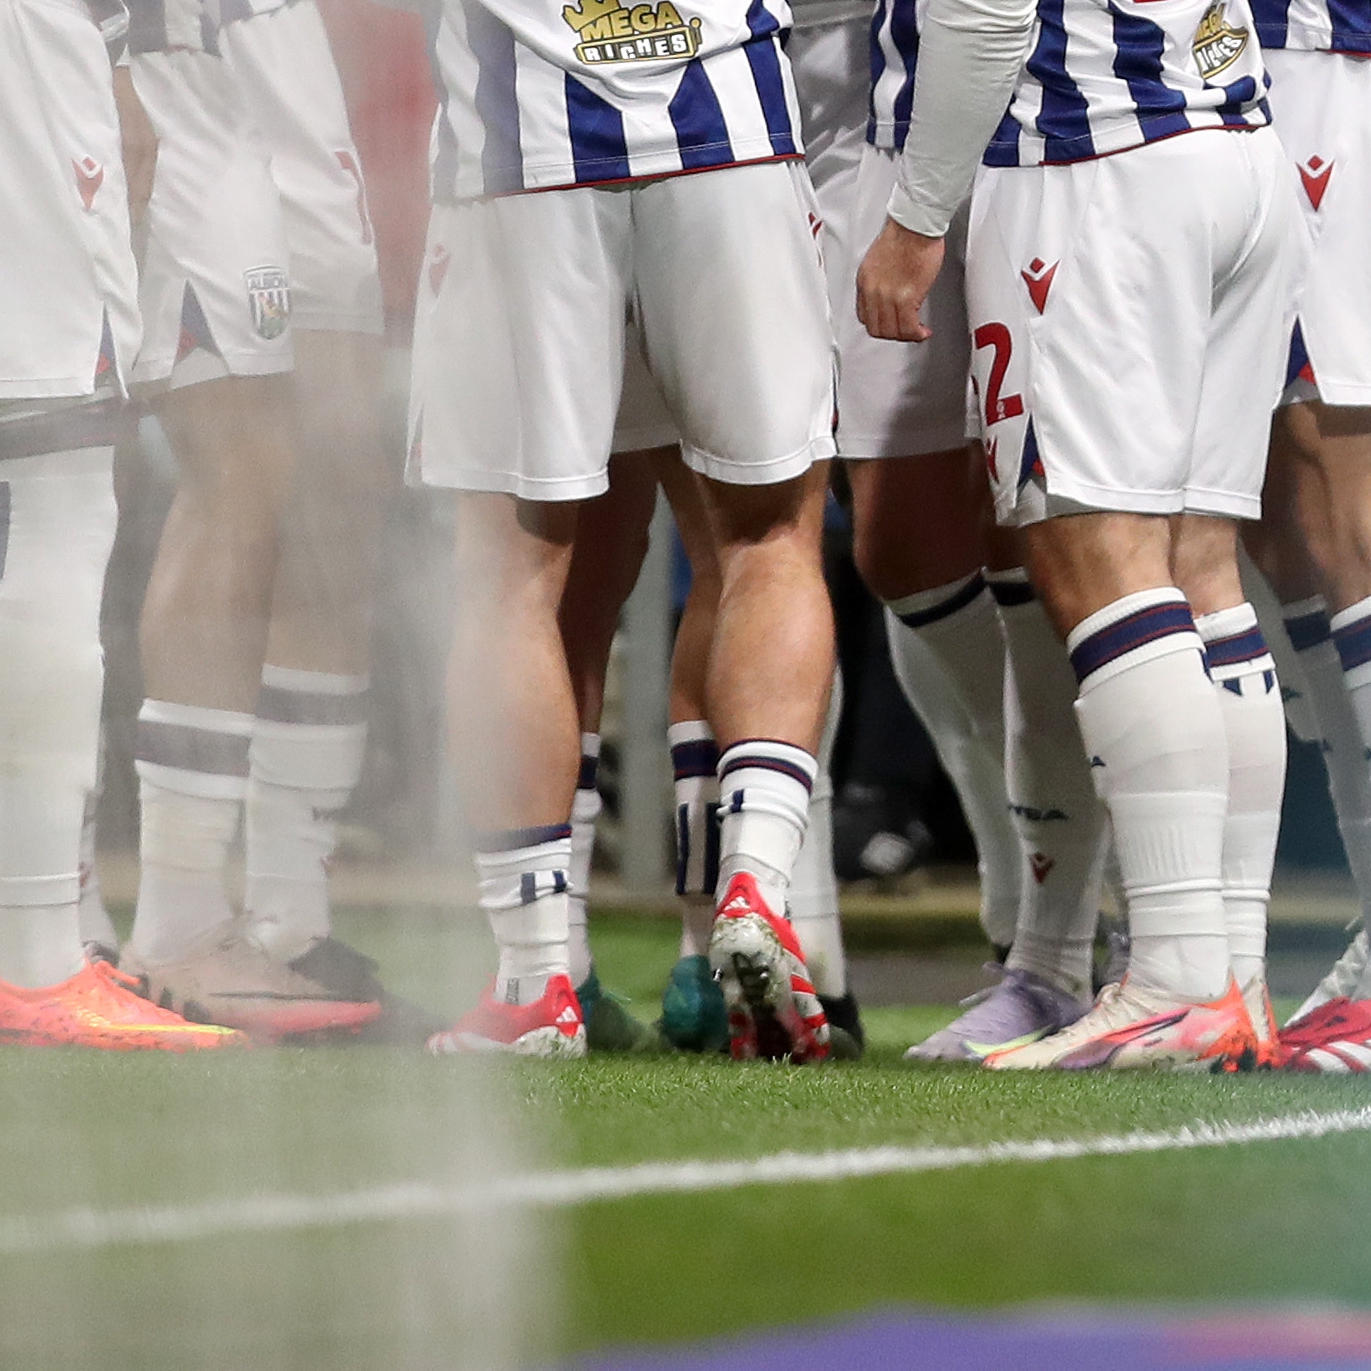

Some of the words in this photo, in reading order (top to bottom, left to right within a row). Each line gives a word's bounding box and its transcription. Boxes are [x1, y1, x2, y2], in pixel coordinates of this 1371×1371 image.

[580, 0, 684, 42] MEGA
[583, 33, 688, 62] RICHES
[971, 321, 1026, 427] 2
